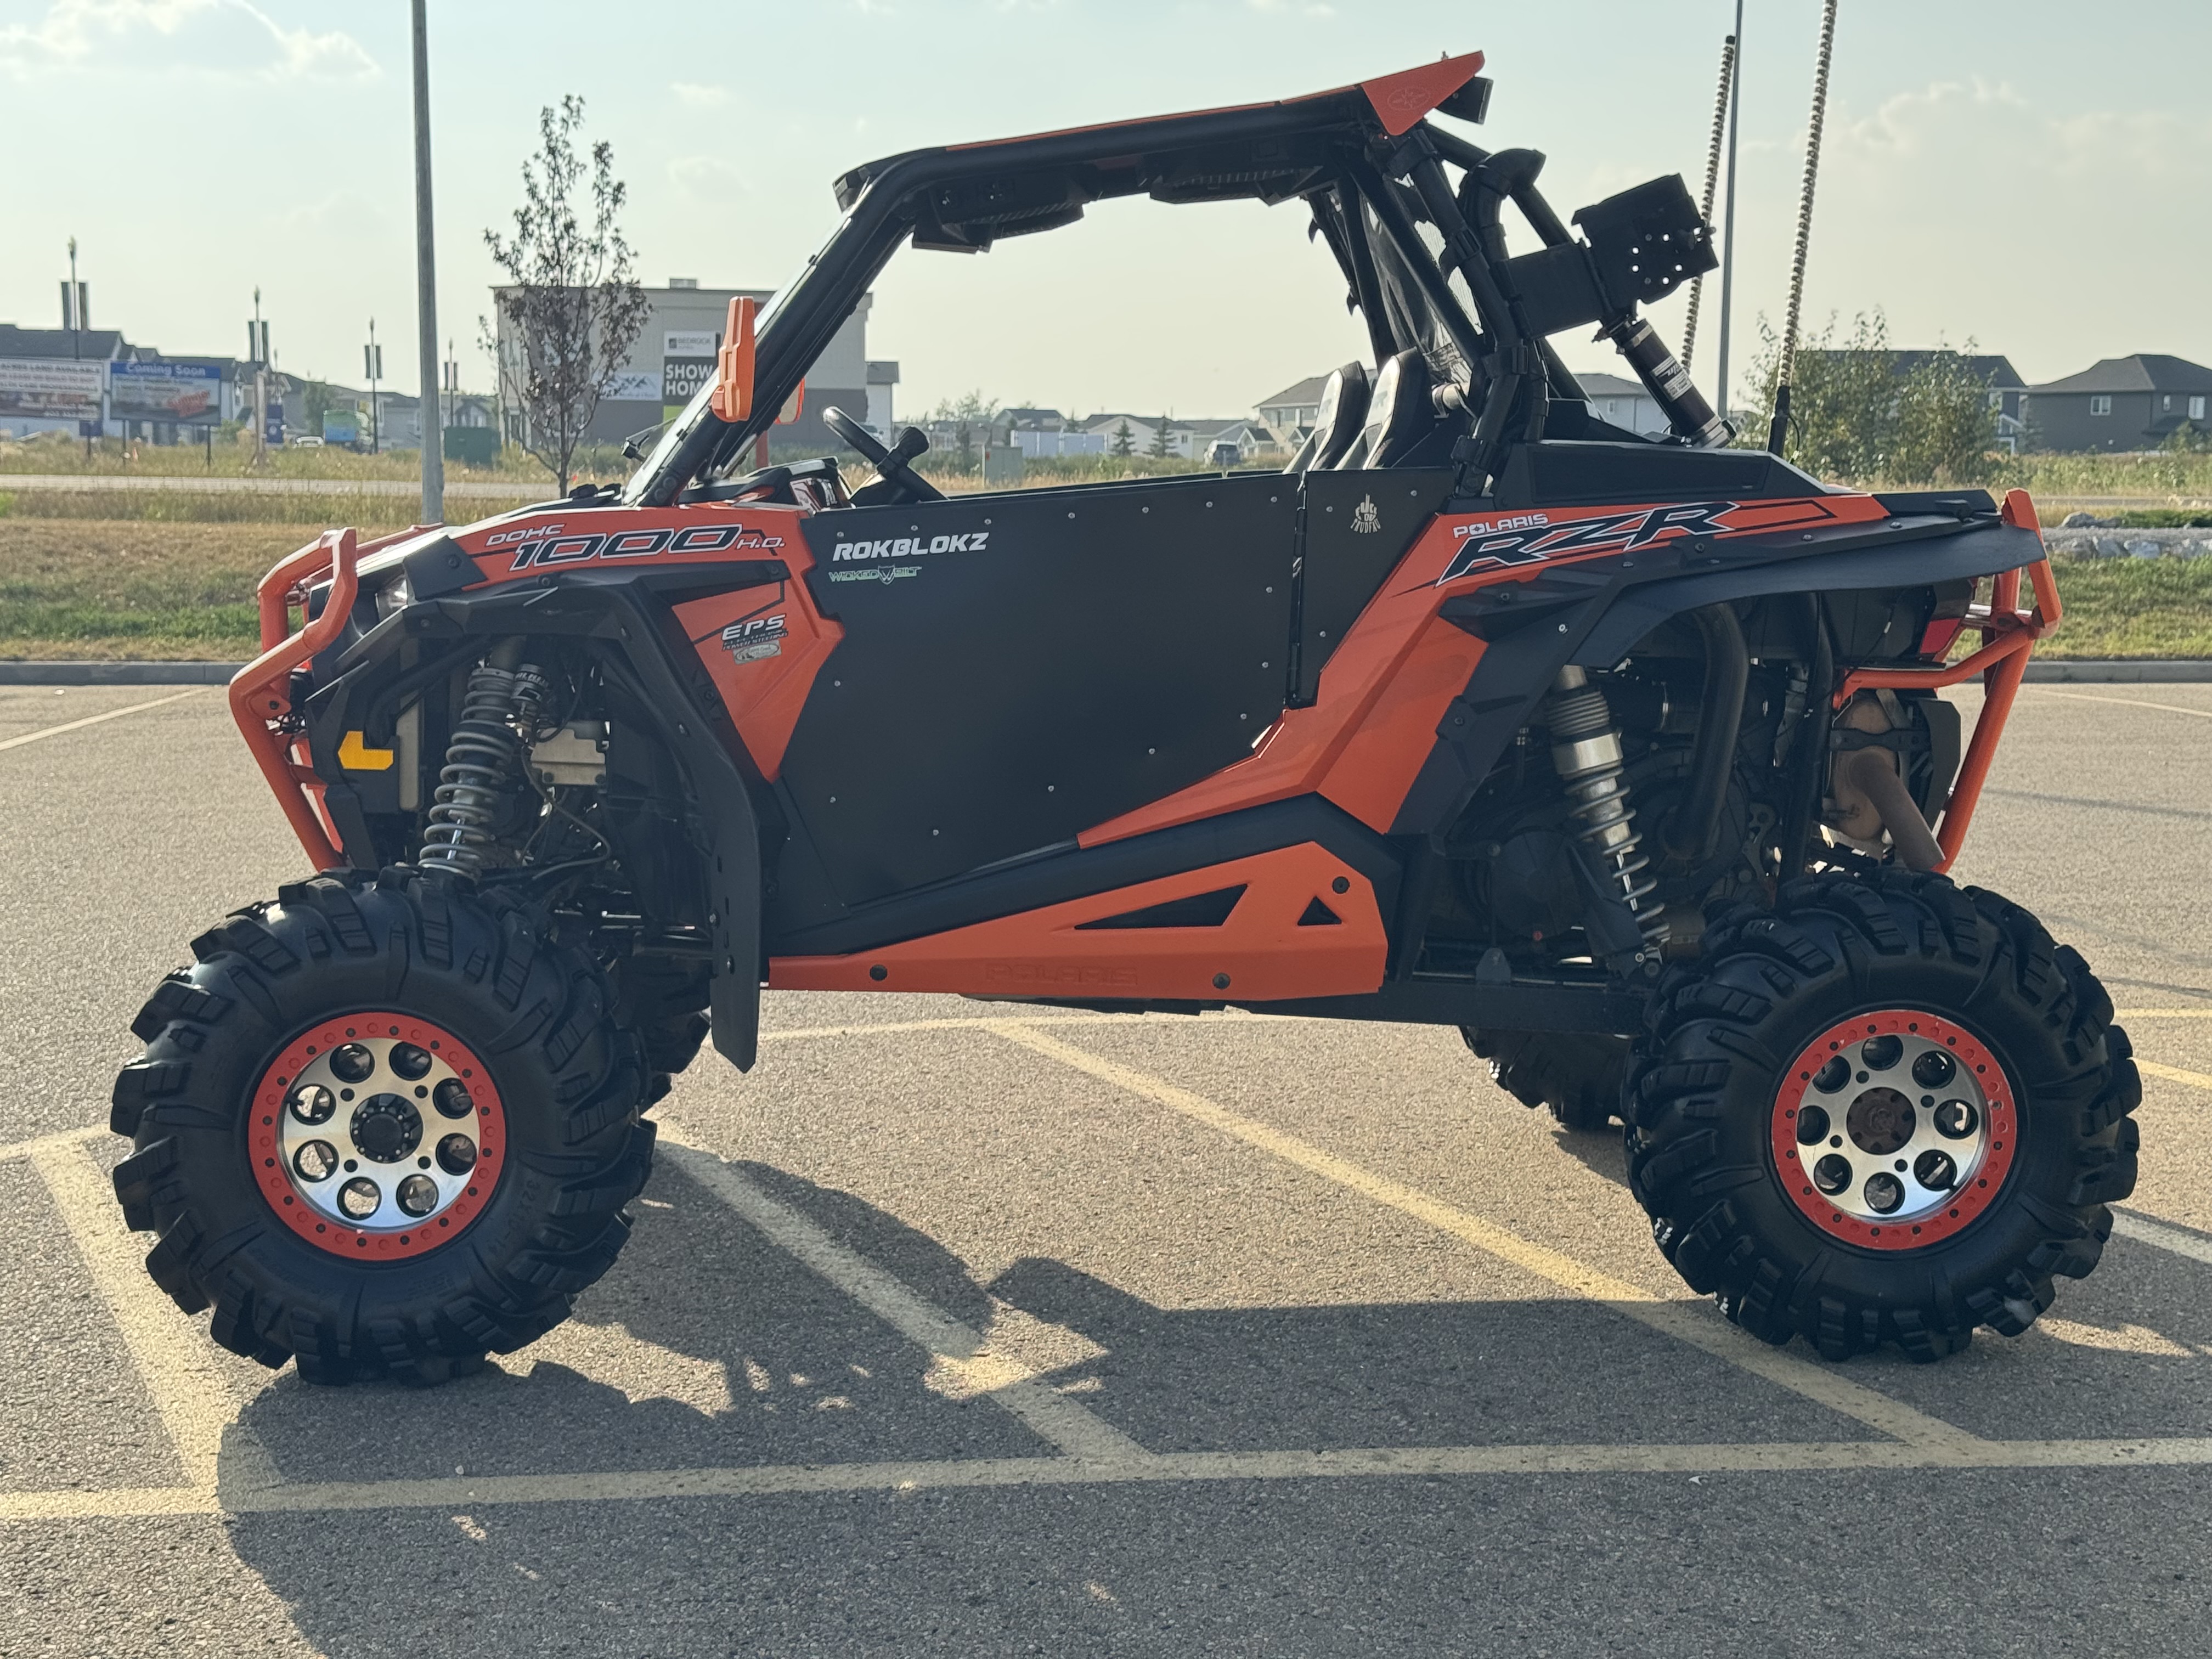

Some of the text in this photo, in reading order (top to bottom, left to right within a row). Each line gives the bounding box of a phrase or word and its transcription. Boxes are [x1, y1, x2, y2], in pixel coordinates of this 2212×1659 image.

[126, 362, 205, 377] Coming Soon
[665, 364, 713, 380] SHOW
[665, 381, 703, 396] HOM
[486, 524, 566, 546] DOHC
[1453, 514, 1549, 538] POLARIS
[509, 524, 742, 572] 1000
[832, 532, 990, 562] ROKBLOKZ
[1434, 501, 1741, 588] RZR
[828, 569, 879, 582] WICKED
[722, 614, 786, 640] EPS
[986, 964, 1138, 986] POLARIS
